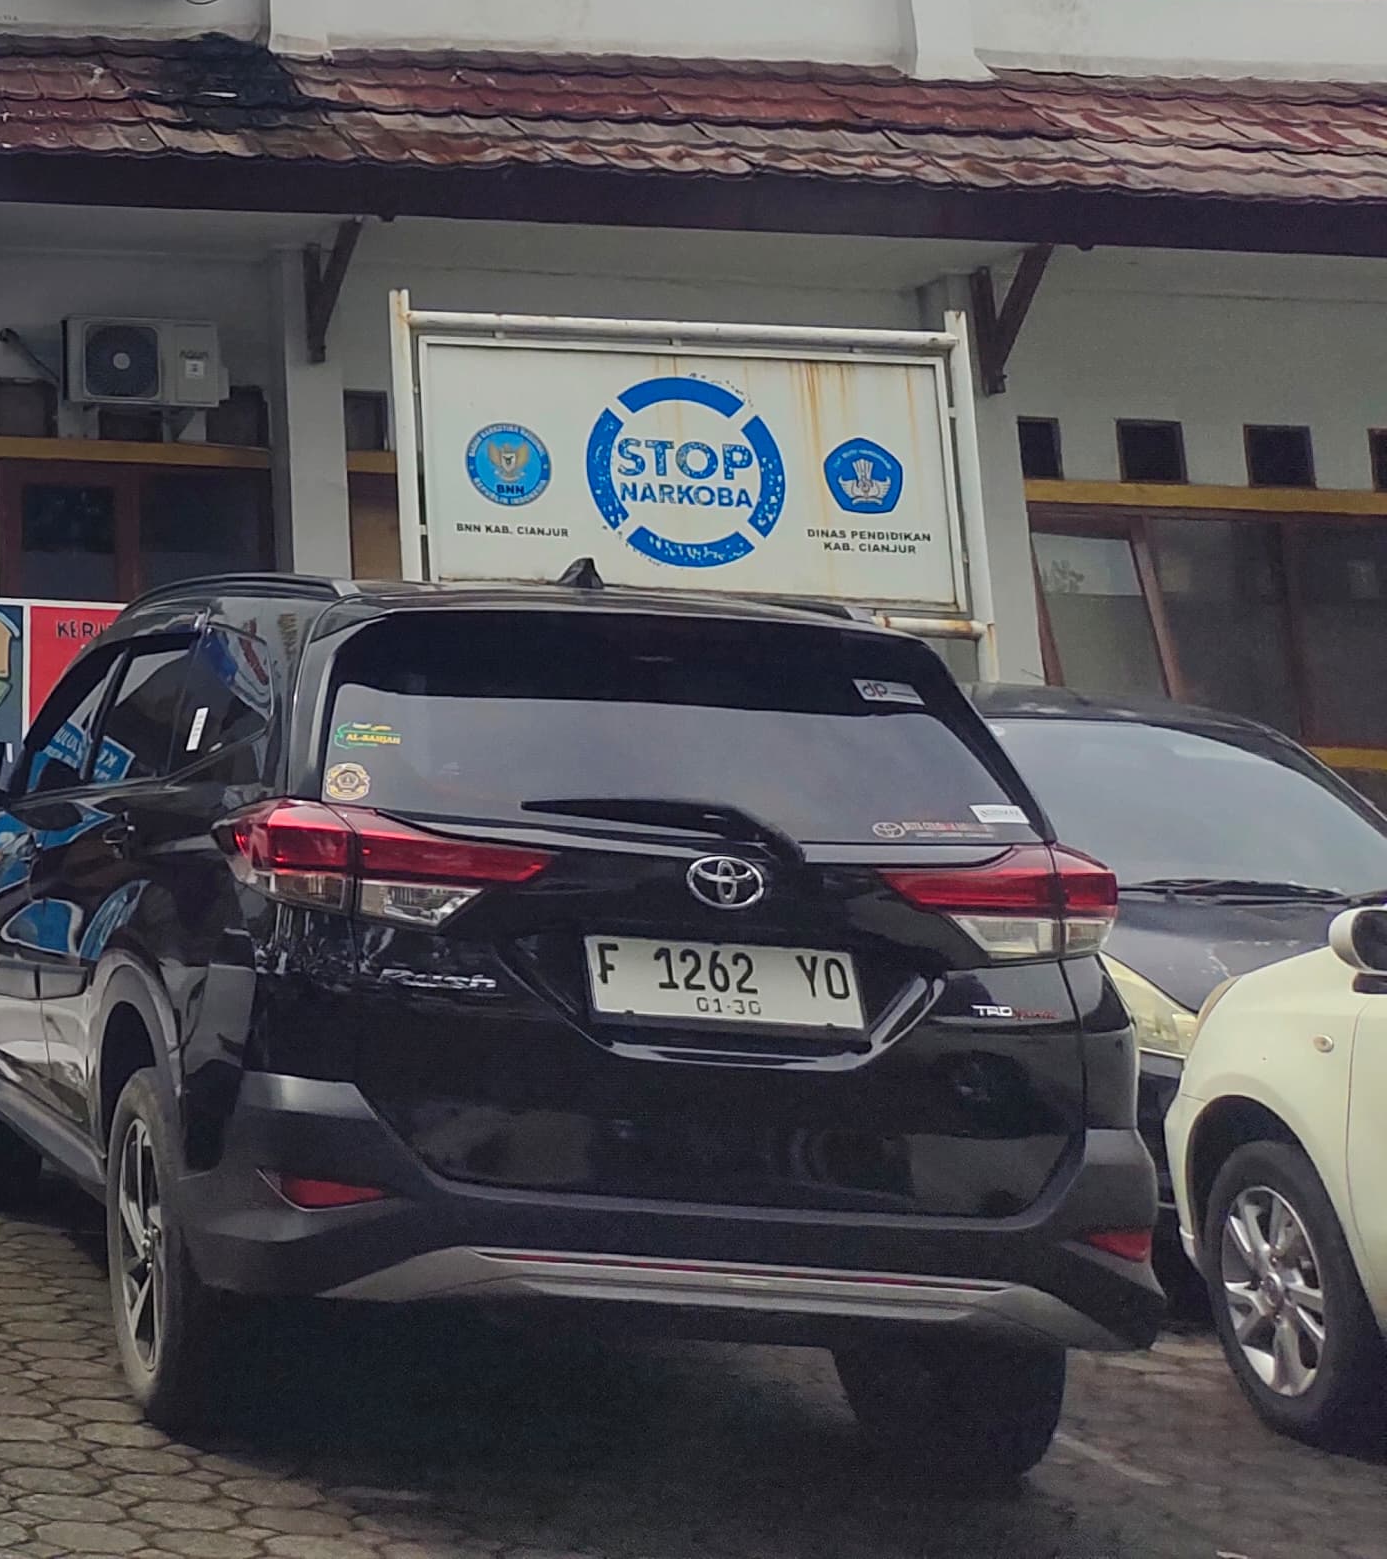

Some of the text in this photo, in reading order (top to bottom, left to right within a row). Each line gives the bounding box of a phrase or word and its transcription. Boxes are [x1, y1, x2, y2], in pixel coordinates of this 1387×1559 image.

[617, 437, 754, 481] STOP
[496, 484, 525, 495] BNN
[619, 481, 754, 508] NARKOBA
[456, 523, 569, 538] BNN KAB. CIANJUR
[807, 528, 932, 542] DINAS PENDIDIKAN
[823, 541, 916, 554] KAB. CIANJUR
[596, 942, 851, 1000] F 1262 YO
[970, 1004, 1013, 1017] TRD
